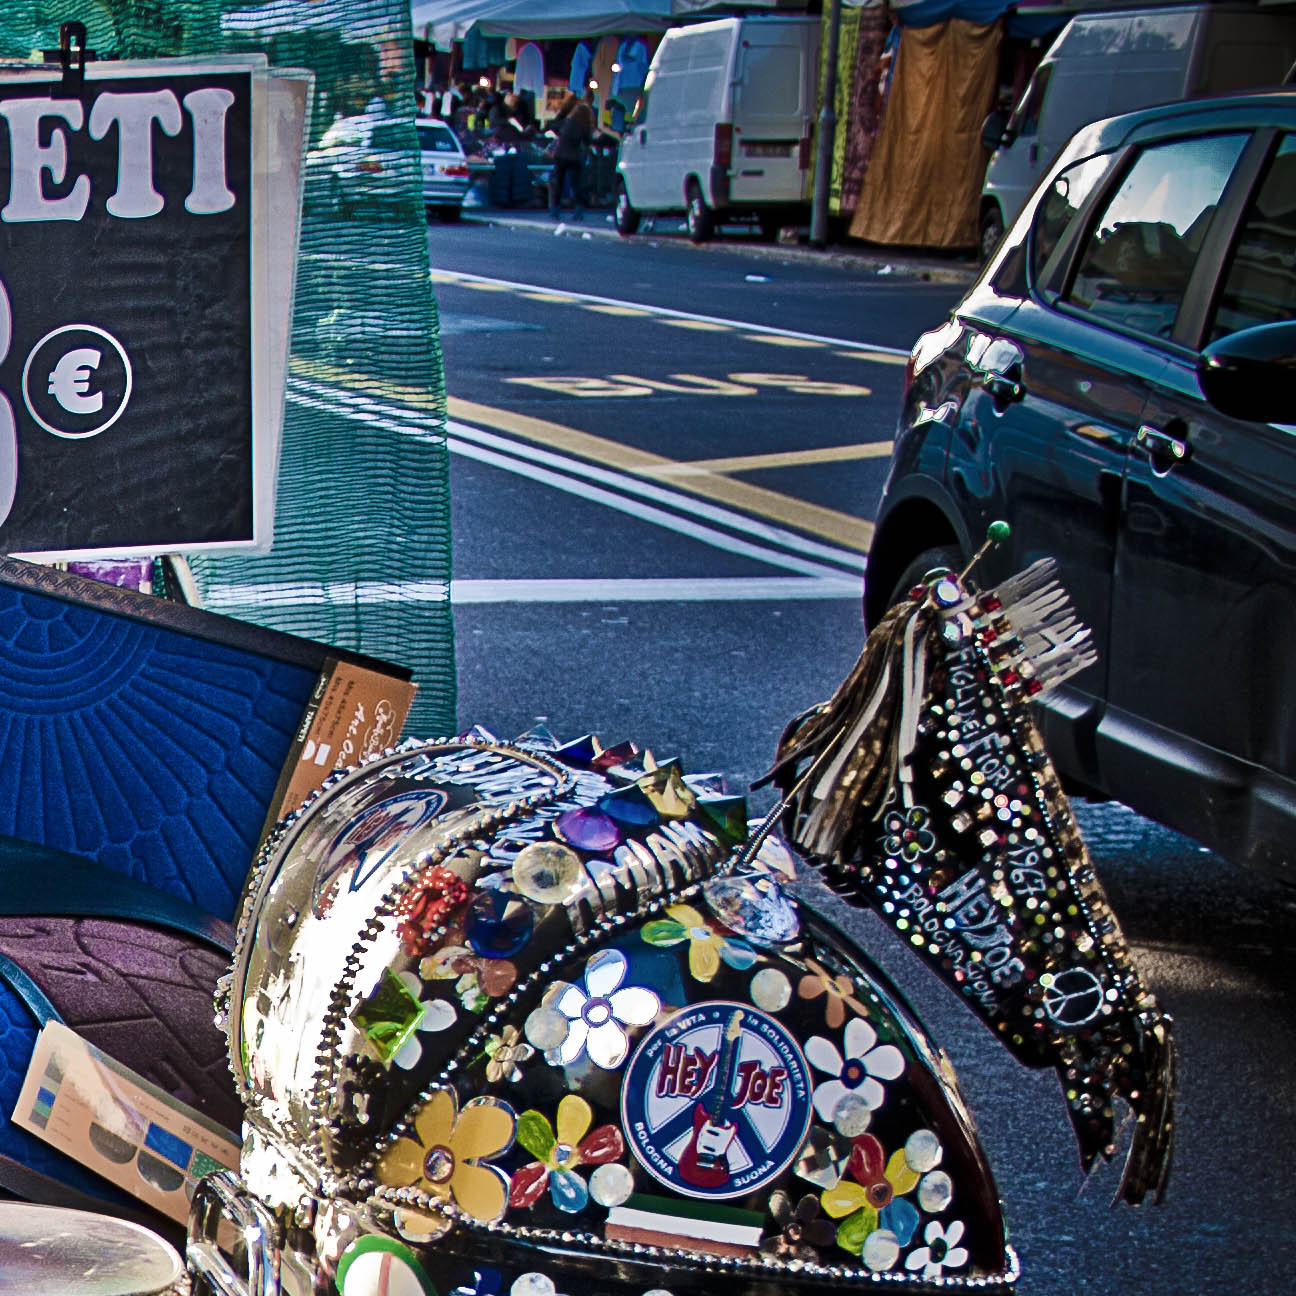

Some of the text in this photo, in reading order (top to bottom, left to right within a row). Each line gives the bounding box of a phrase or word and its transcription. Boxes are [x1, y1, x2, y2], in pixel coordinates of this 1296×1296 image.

[505, 371, 872, 398] BUS
[964, 731, 1016, 791] FIORI
[1008, 844, 1047, 897] 1967
[676, 1012, 706, 1032] VITA
[657, 1042, 788, 1109] HEY JOE
[634, 1121, 776, 1188] BOLOGNA SUONA
